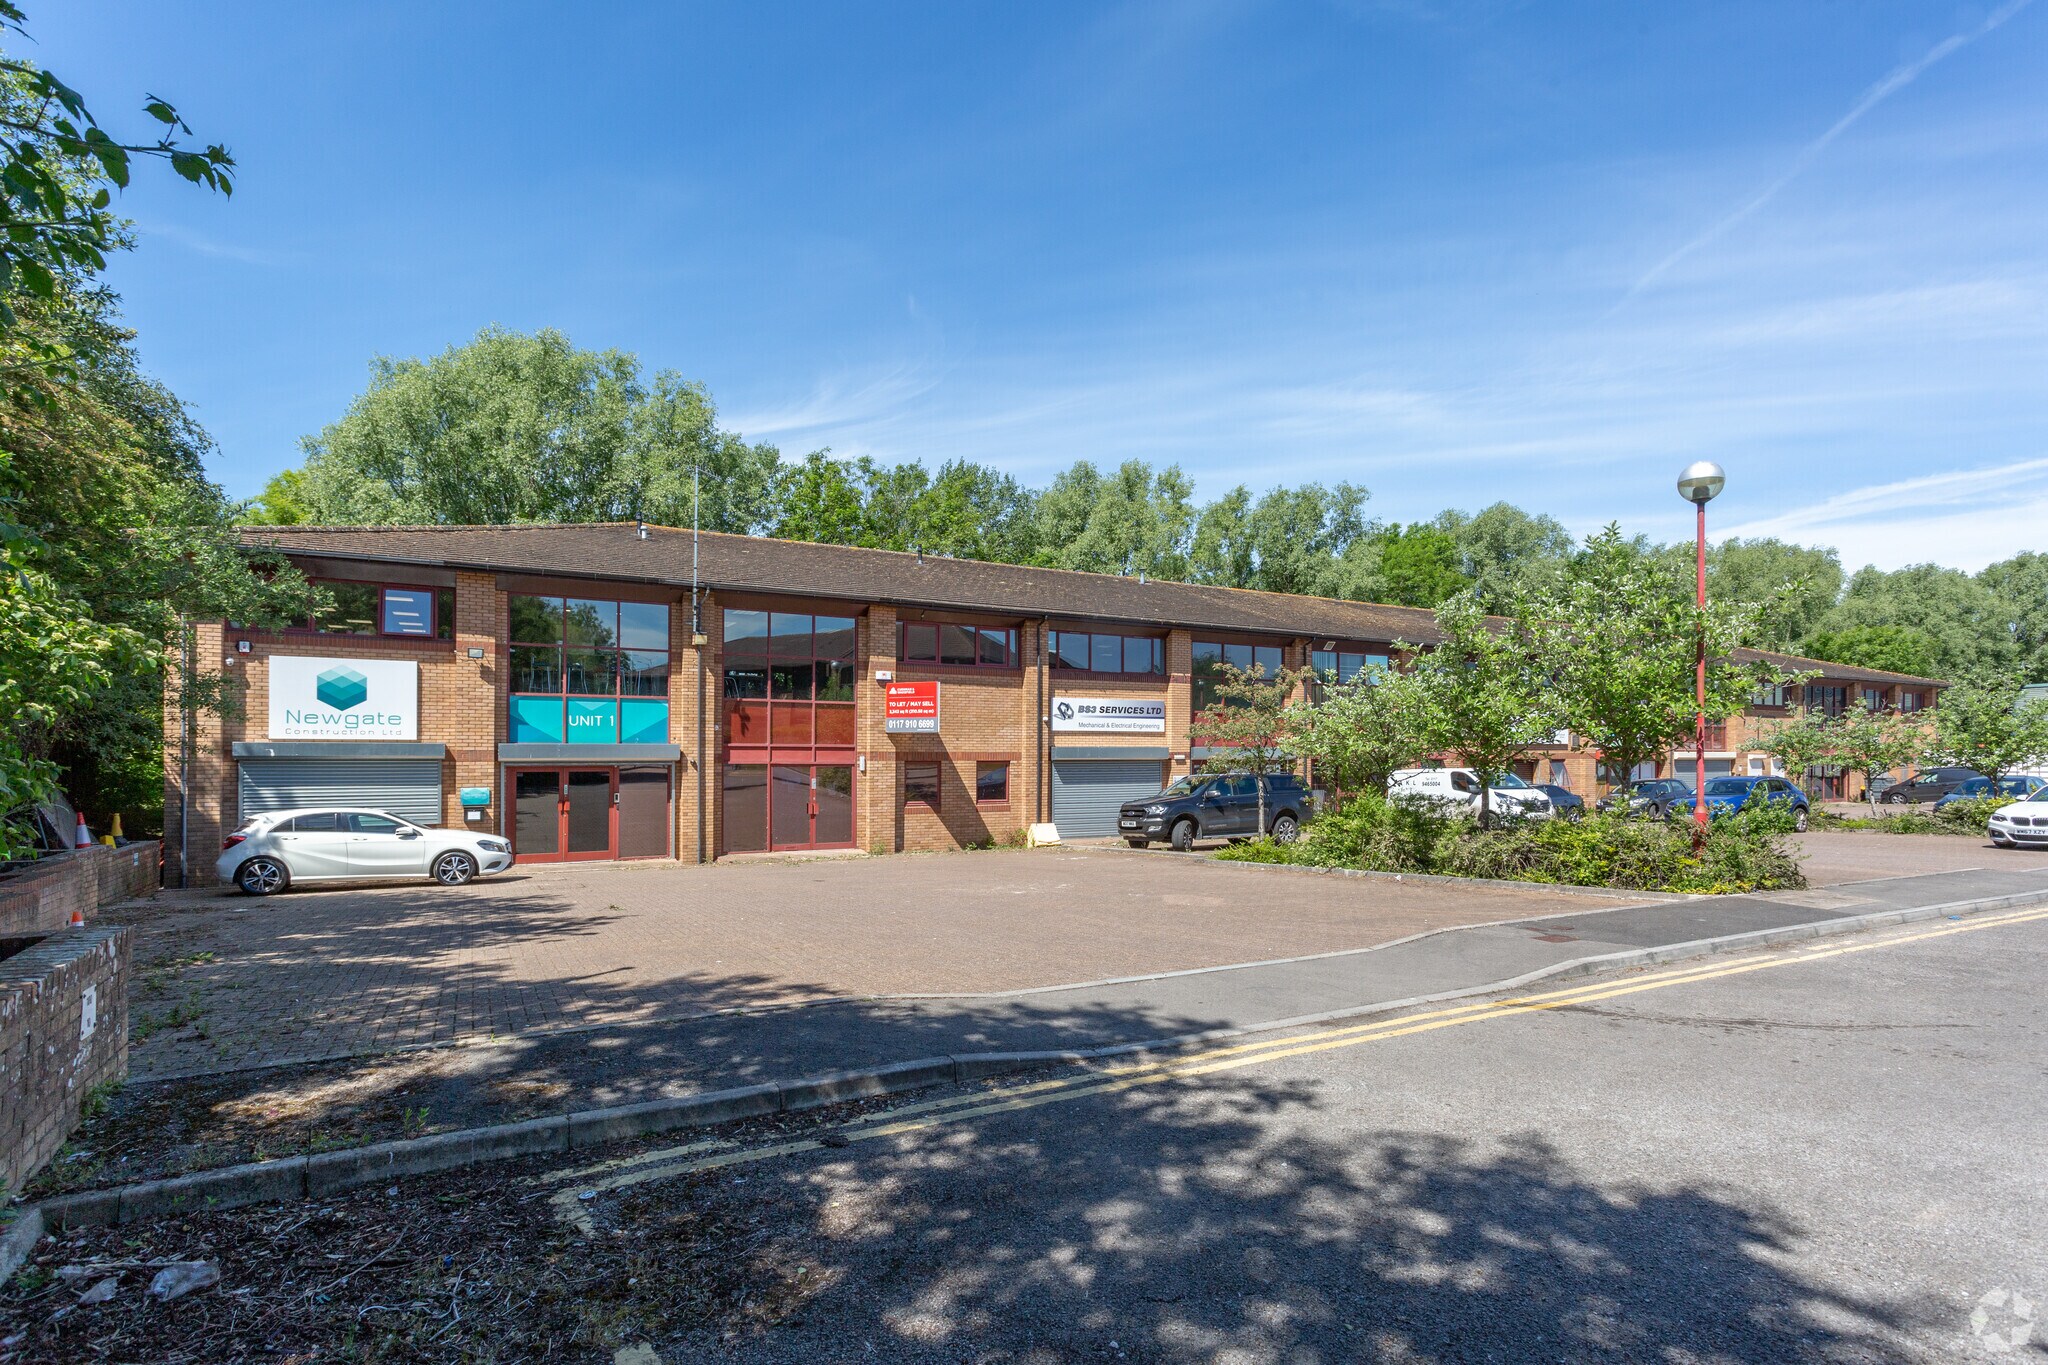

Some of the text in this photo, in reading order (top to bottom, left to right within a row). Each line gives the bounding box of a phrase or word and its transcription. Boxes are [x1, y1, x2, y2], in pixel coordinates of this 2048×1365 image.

[1078, 705, 1162, 715] BS3 SERVICES LTD
[286, 709, 402, 729] Newgate
[569, 715, 615, 727] UNIT 1
[889, 719, 935, 729] 0117 910 6699
[1133, 722, 1160, 730] Engineering
